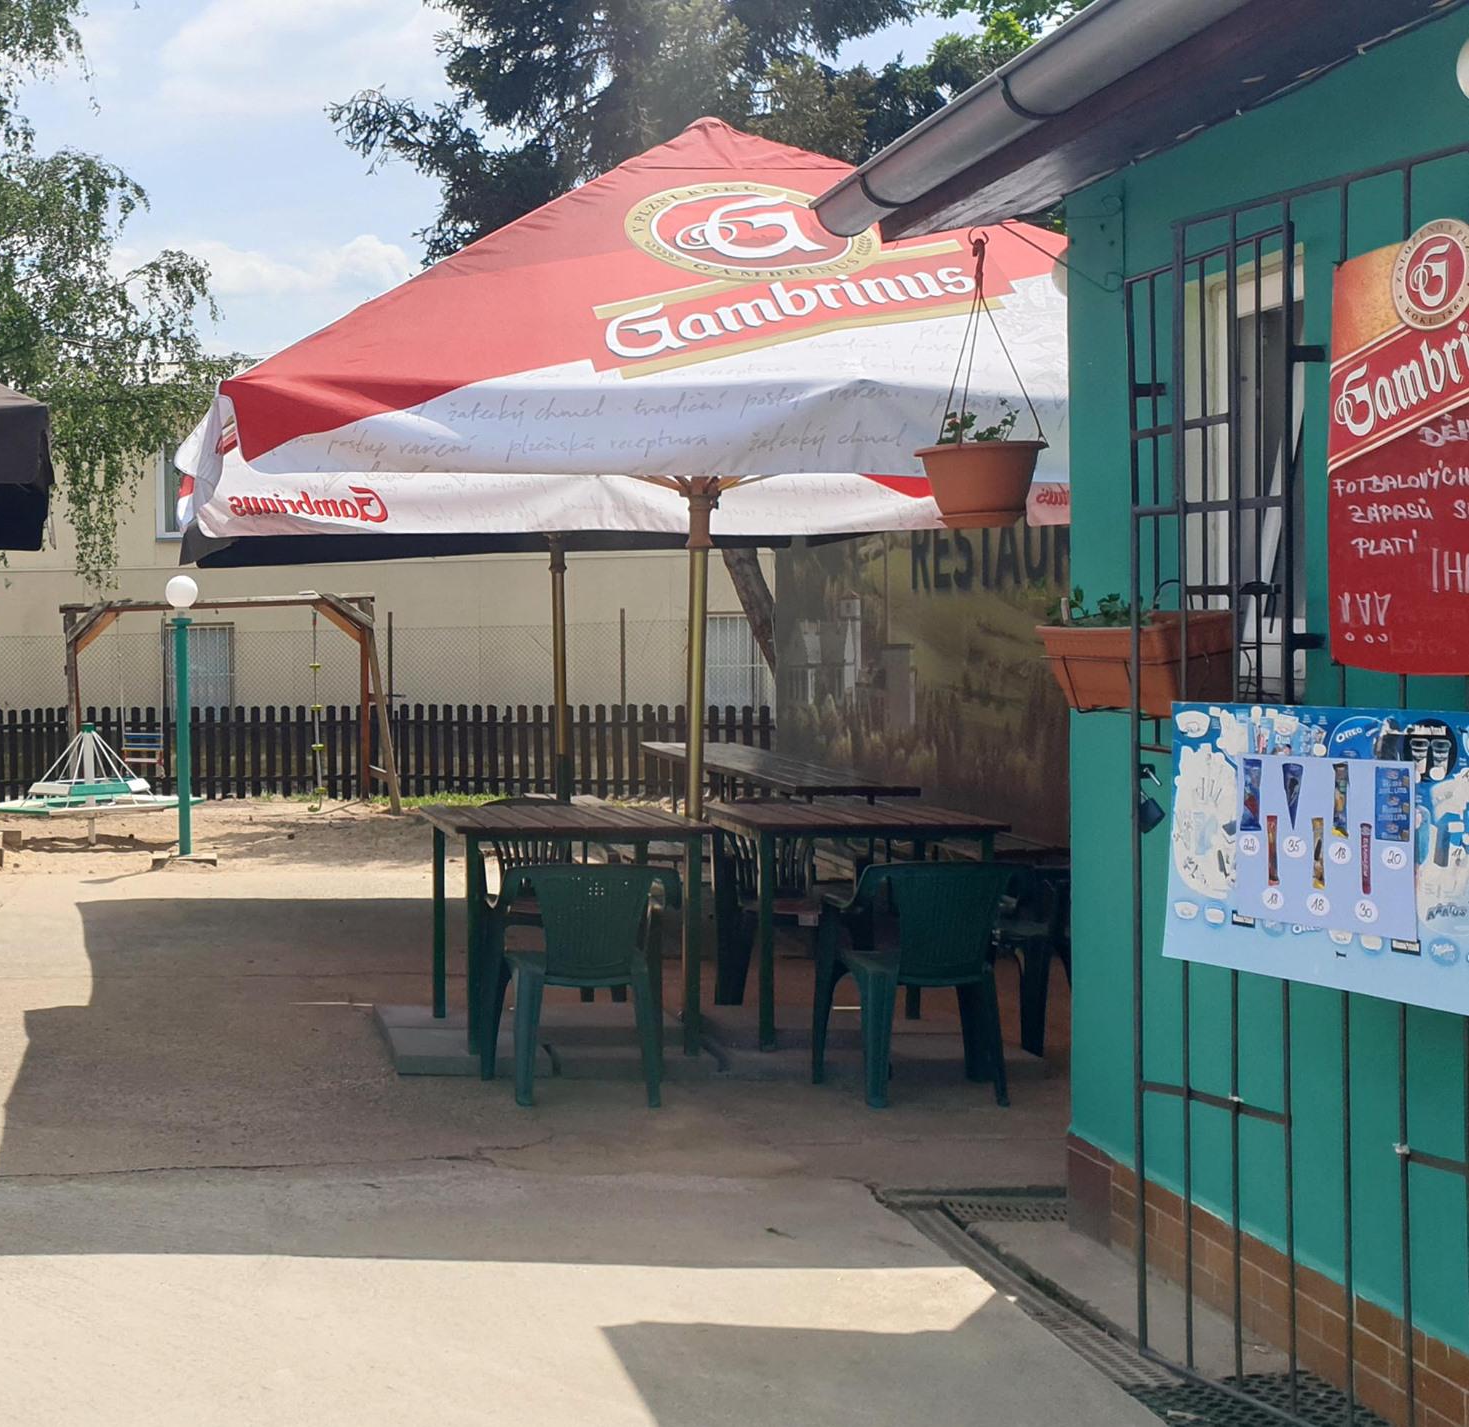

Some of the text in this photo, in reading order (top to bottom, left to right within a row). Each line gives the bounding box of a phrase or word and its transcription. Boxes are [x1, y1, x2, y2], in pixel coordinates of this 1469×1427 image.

[692, 257, 860, 278] GAMBRINUS
[604, 266, 976, 358] Gambrinus
[1287, 839, 1301, 852] 35
[1387, 850, 1402, 865] 20
[1311, 898, 1324, 911] 18
[1359, 902, 1372, 918] 30
